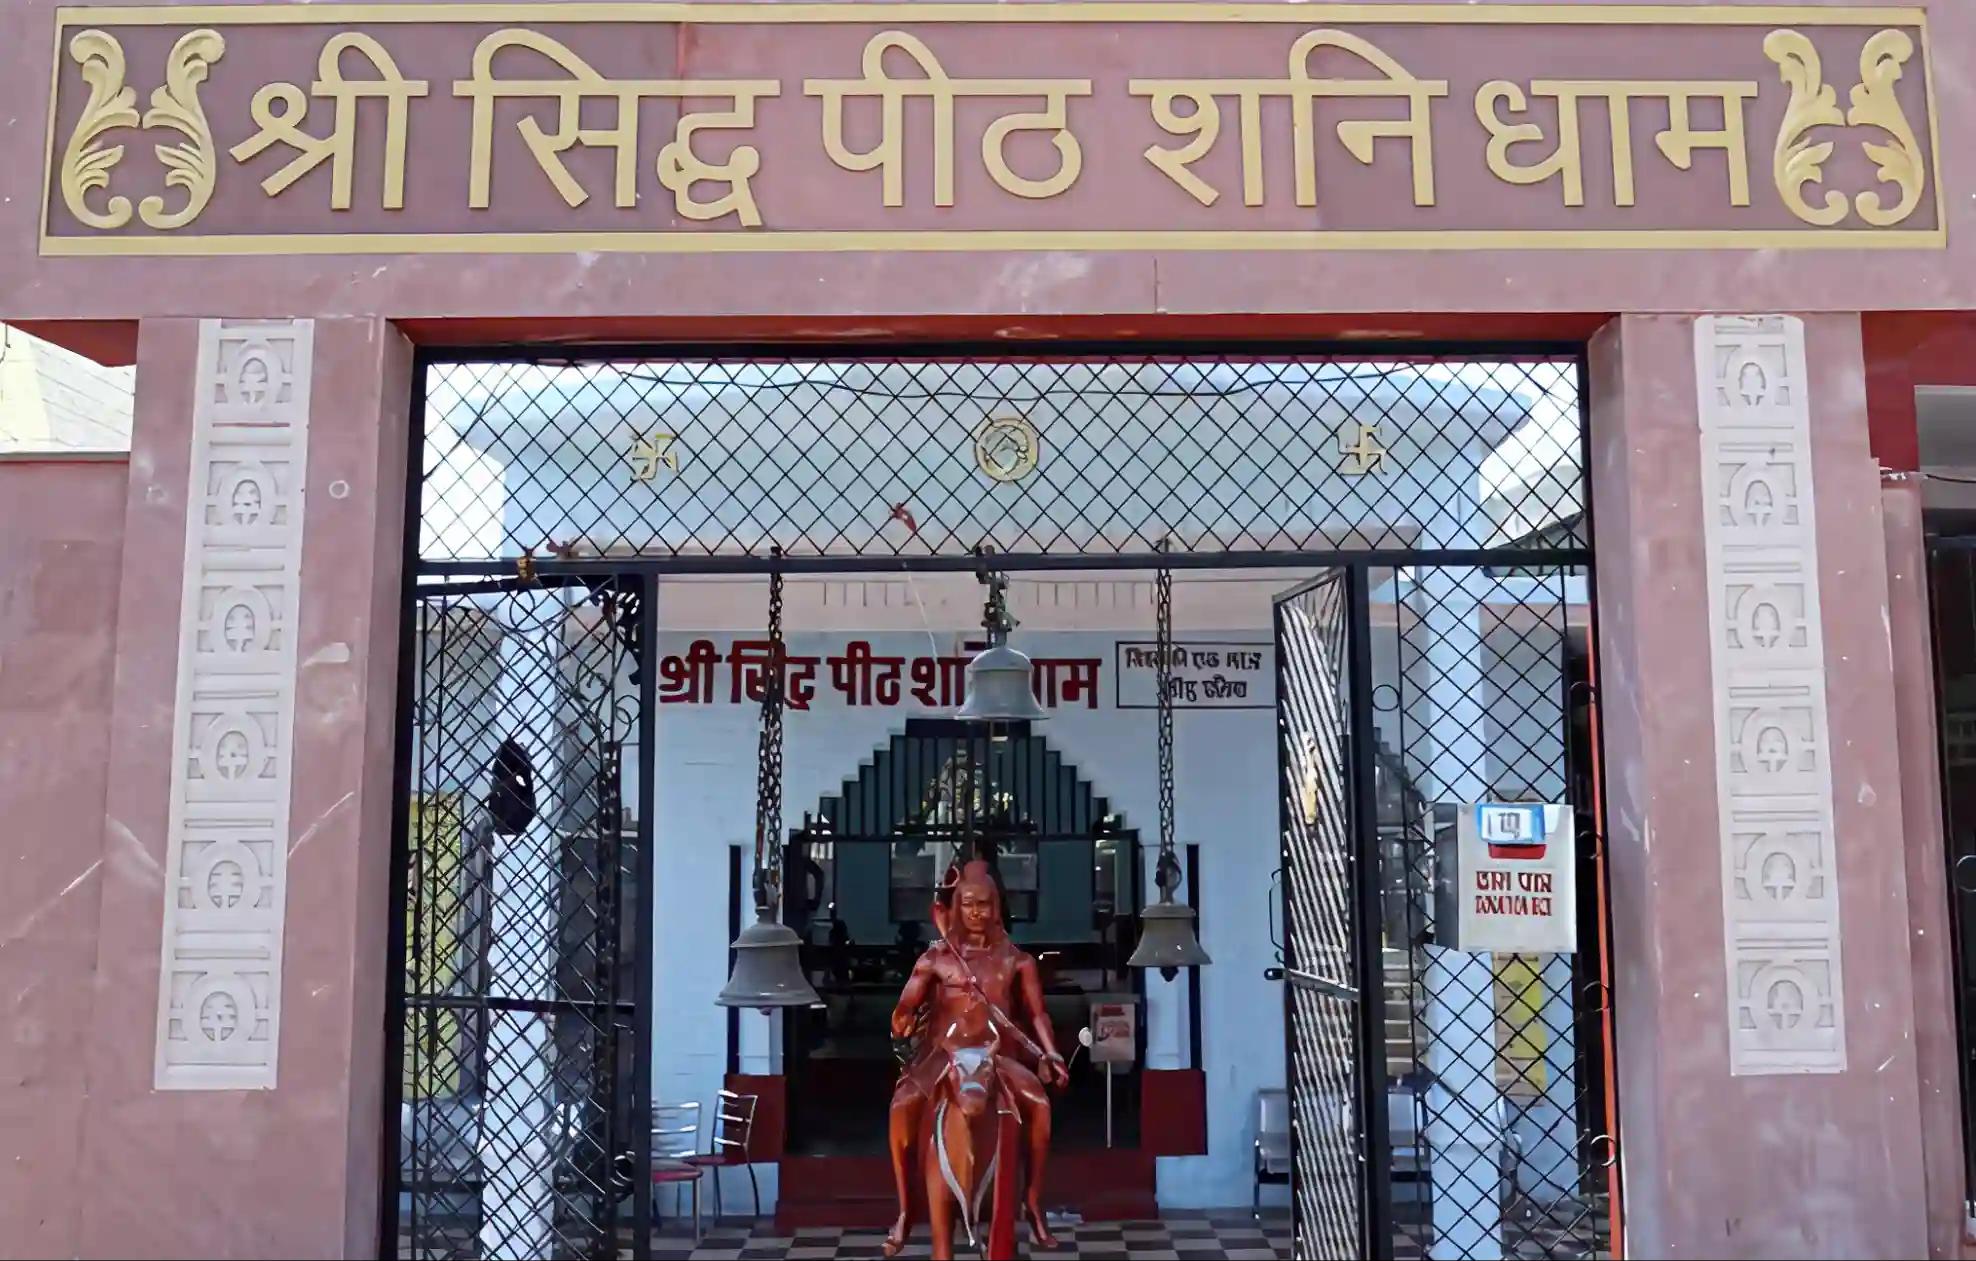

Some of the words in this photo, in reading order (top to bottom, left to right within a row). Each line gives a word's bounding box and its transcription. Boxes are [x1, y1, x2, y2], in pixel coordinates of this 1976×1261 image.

[228, 31, 429, 211] श्री
[452, 27, 781, 227] सिद्ध
[803, 30, 1093, 207] पीठ
[1129, 28, 1449, 207] शनि
[1474, 79, 1758, 207] धाम
[658, 639, 722, 704] श्री
[826, 640, 906, 706] पीठ
